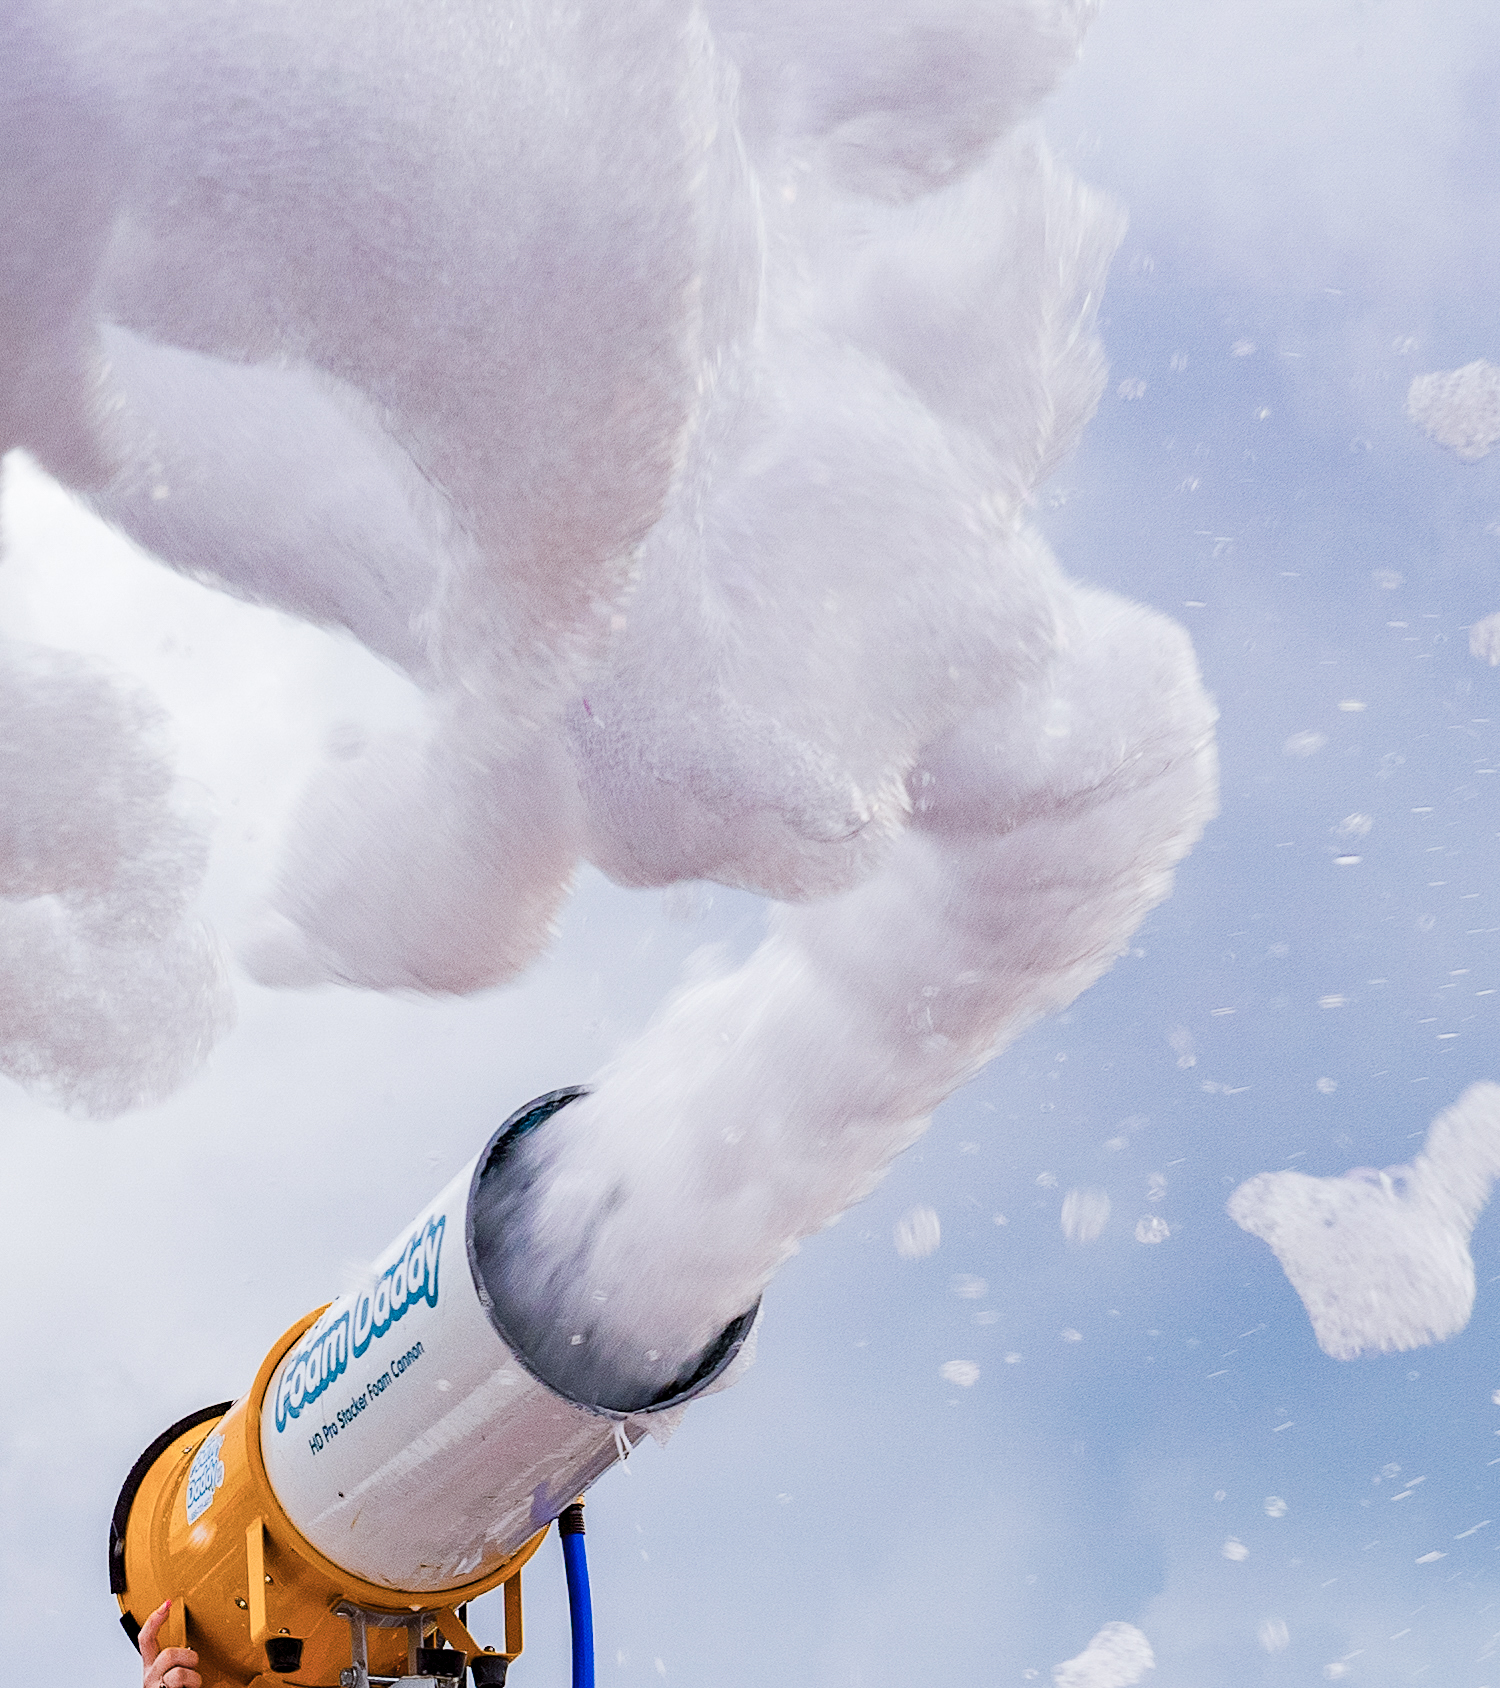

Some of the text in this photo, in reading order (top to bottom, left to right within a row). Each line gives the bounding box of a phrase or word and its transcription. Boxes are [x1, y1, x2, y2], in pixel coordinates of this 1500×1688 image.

[275, 1214, 446, 1434] Foam Daddy
[308, 1341, 425, 1455] HD Pro Stacker Foam Cannon
